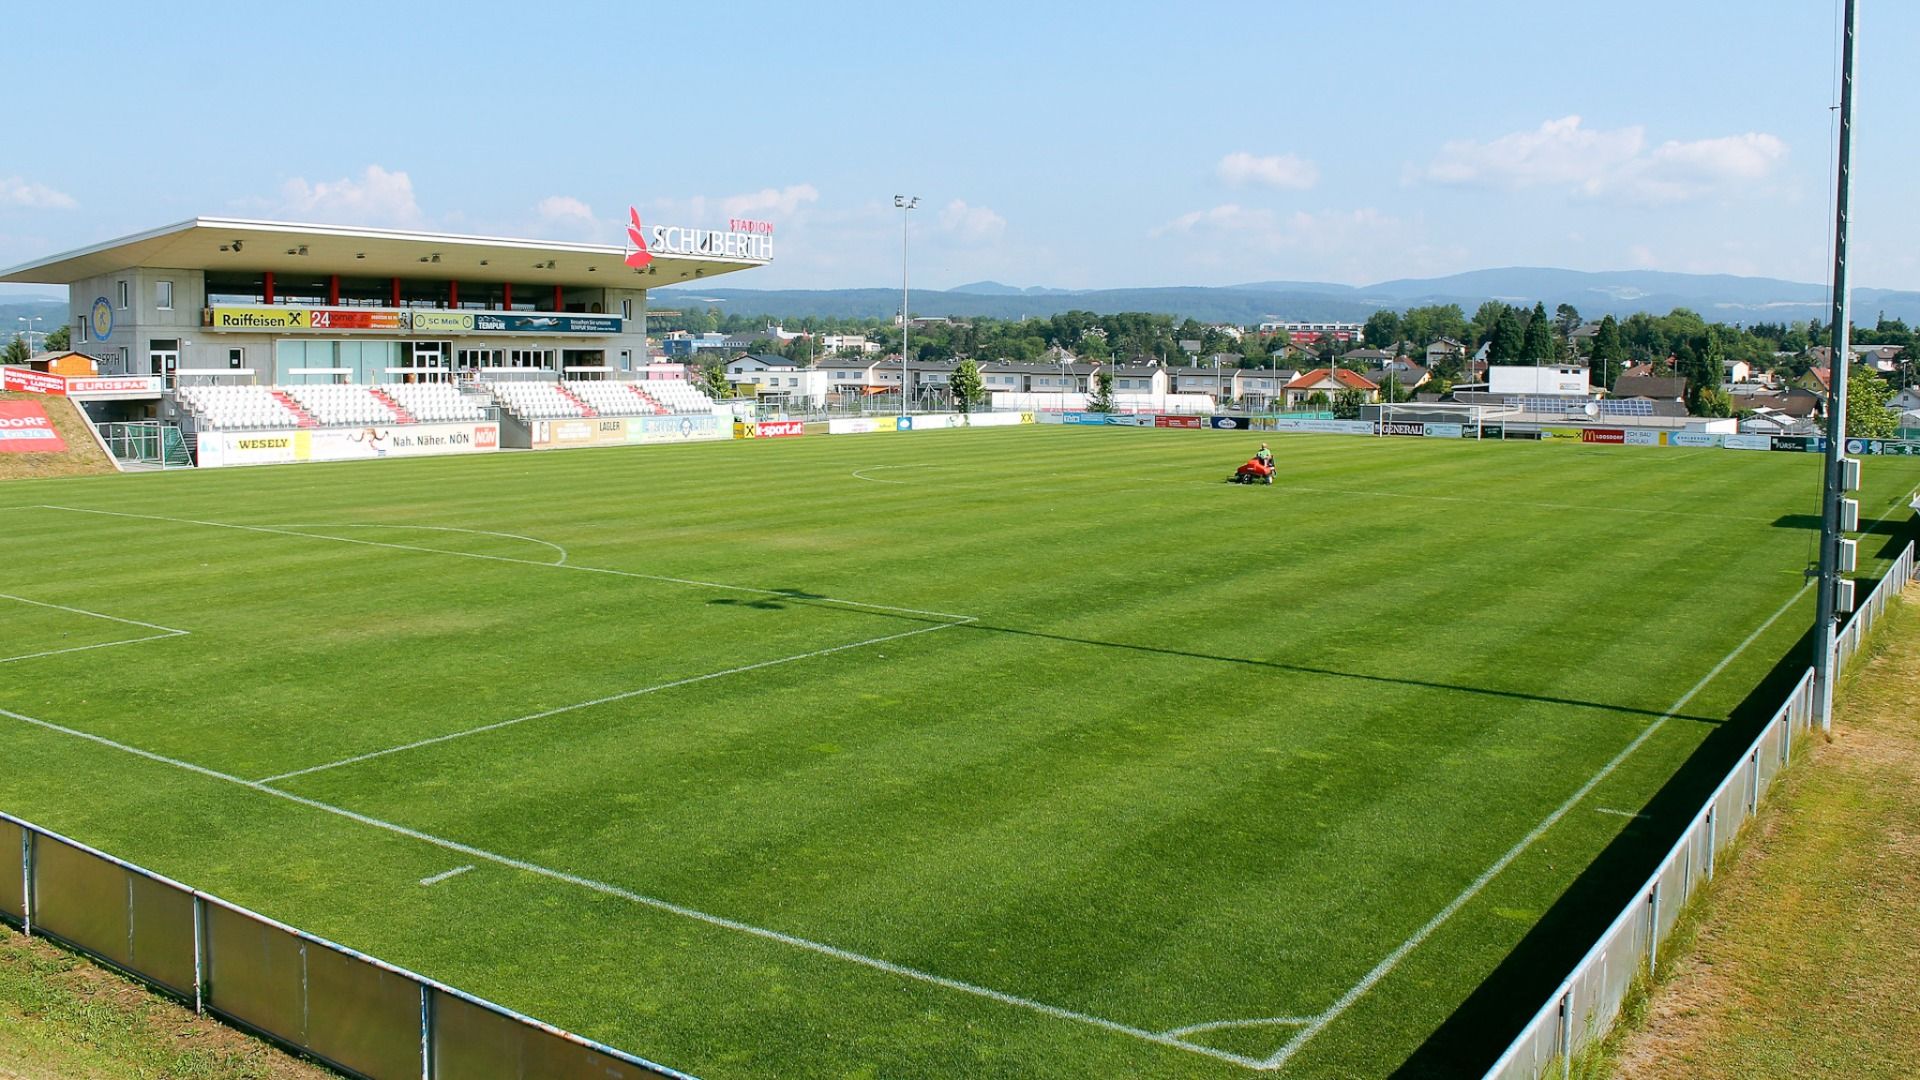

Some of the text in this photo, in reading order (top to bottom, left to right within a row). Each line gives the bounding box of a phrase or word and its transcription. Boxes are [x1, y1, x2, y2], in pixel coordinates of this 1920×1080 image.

[729, 218, 773, 233] STADION
[652, 224, 773, 258] SCHUBERTH
[223, 313, 285, 327] Raiffeisen
[311, 311, 331, 327] 24
[428, 318, 460, 327] SC Melk
[478, 321, 506, 330] TEMPUR
[5, 376, 28, 385] KARL
[76, 380, 148, 391] EUROSPAR
[23, 385, 47, 393] MELK
[755, 421, 803, 436] k-sport.at
[1382, 424, 1423, 435] GENERALI
[238, 438, 288, 450] WESELY
[393, 432, 469, 447] Nah. Näher. NÖN
